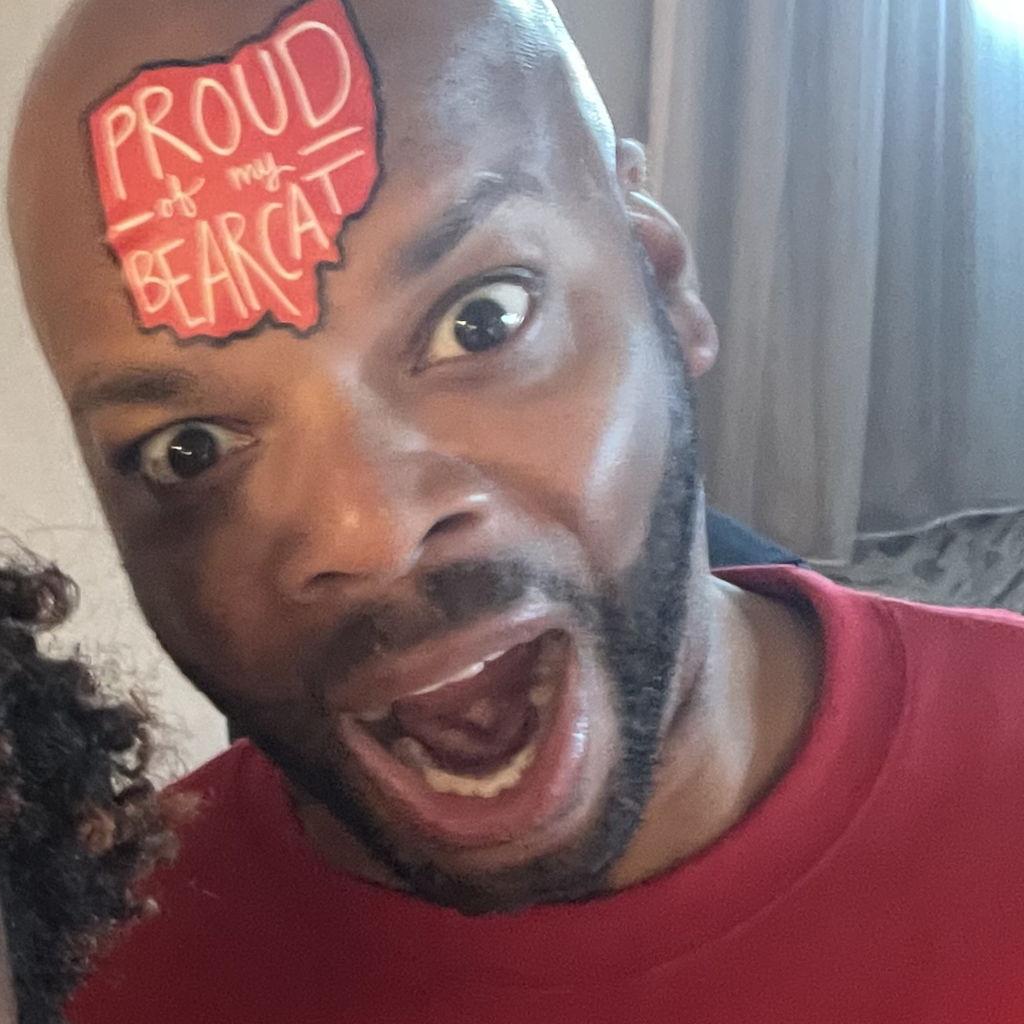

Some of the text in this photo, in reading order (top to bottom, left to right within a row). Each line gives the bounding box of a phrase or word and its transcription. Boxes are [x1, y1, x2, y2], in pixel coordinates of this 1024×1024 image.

[104, 21, 352, 201] PROUD
[156, 152, 297, 218] of my
[125, 150, 365, 328] BEARCAT
